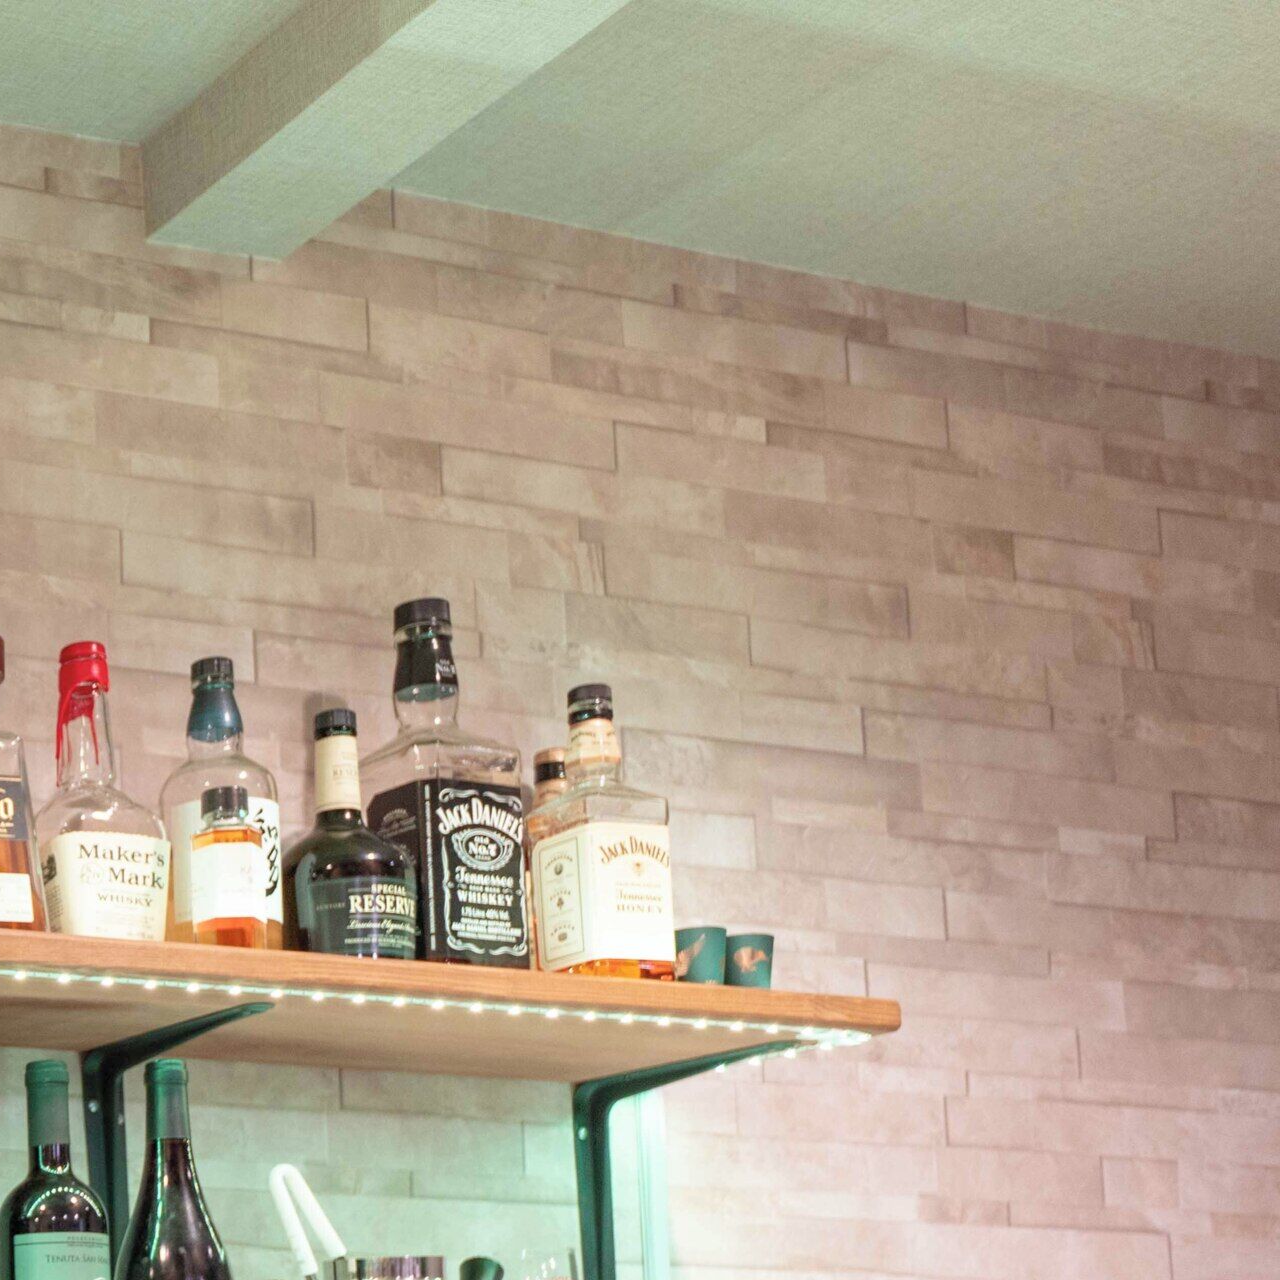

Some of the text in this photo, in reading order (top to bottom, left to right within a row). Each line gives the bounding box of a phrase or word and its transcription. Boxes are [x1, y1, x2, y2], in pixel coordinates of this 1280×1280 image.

[435, 797, 524, 847] JACK DANIEL'S
[77, 842, 166, 867] Maker's
[599, 835, 671, 869] JACK DANIEL'S
[108, 866, 165, 890] Mark
[454, 865, 515, 889] Tennessee
[97, 892, 154, 908] WHISKY
[370, 883, 407, 896] SPECIAL
[456, 889, 515, 907] WHISKEY
[44, 1254, 81, 1265] TENUTA
